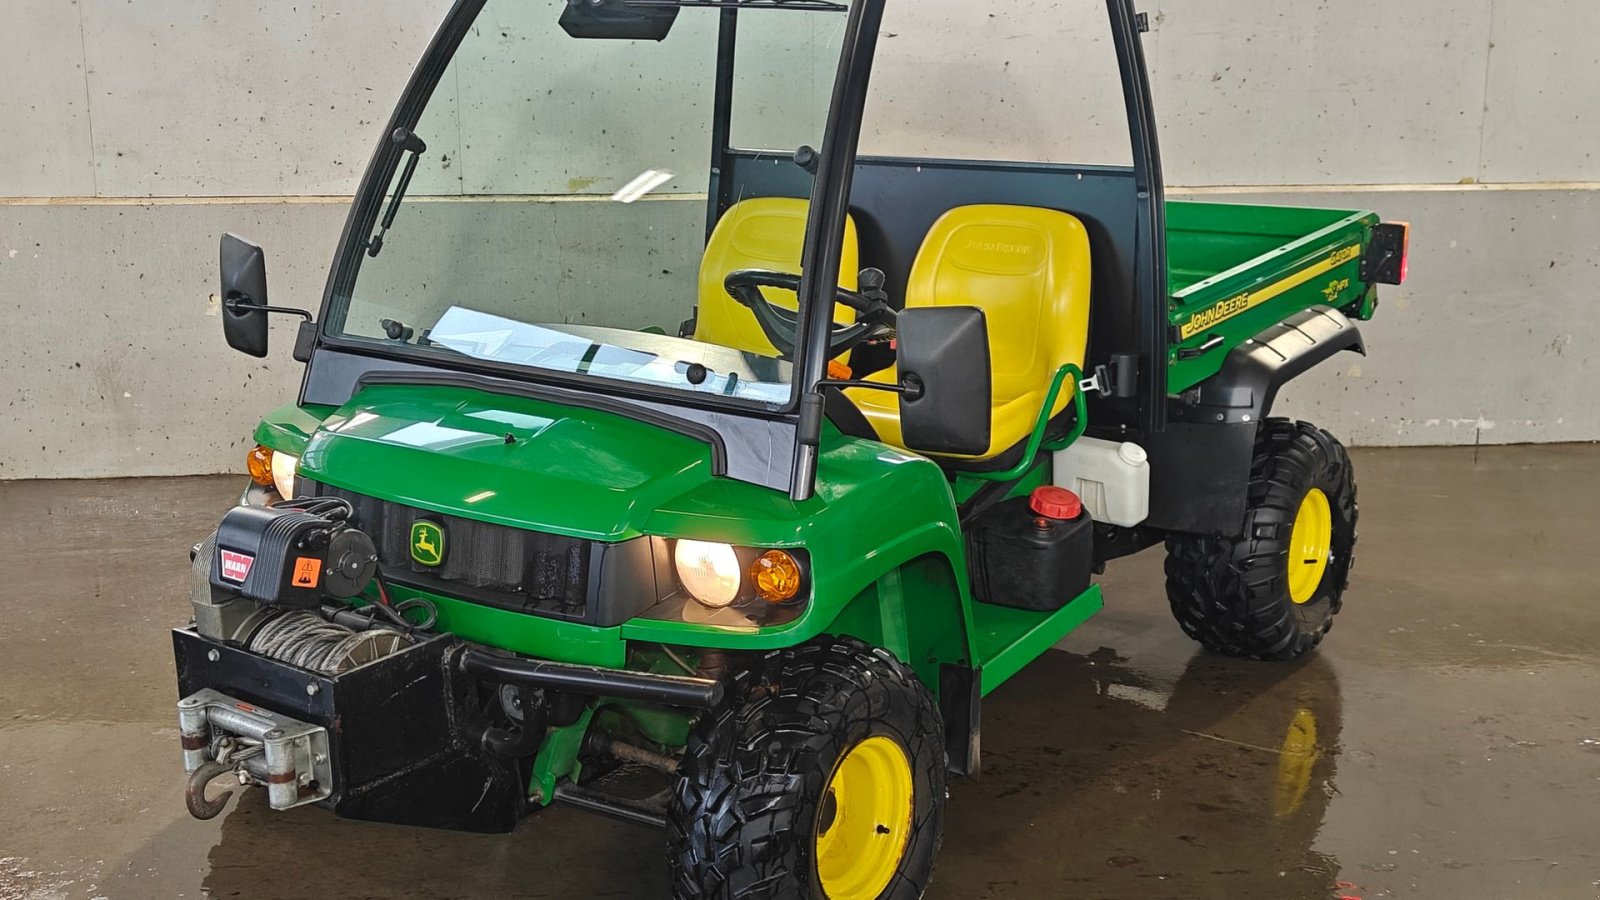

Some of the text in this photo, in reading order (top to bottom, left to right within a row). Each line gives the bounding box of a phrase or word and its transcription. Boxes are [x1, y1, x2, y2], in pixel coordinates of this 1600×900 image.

[1186, 292, 1249, 334] JOHN DEERE
[225, 559, 247, 574] WARN
